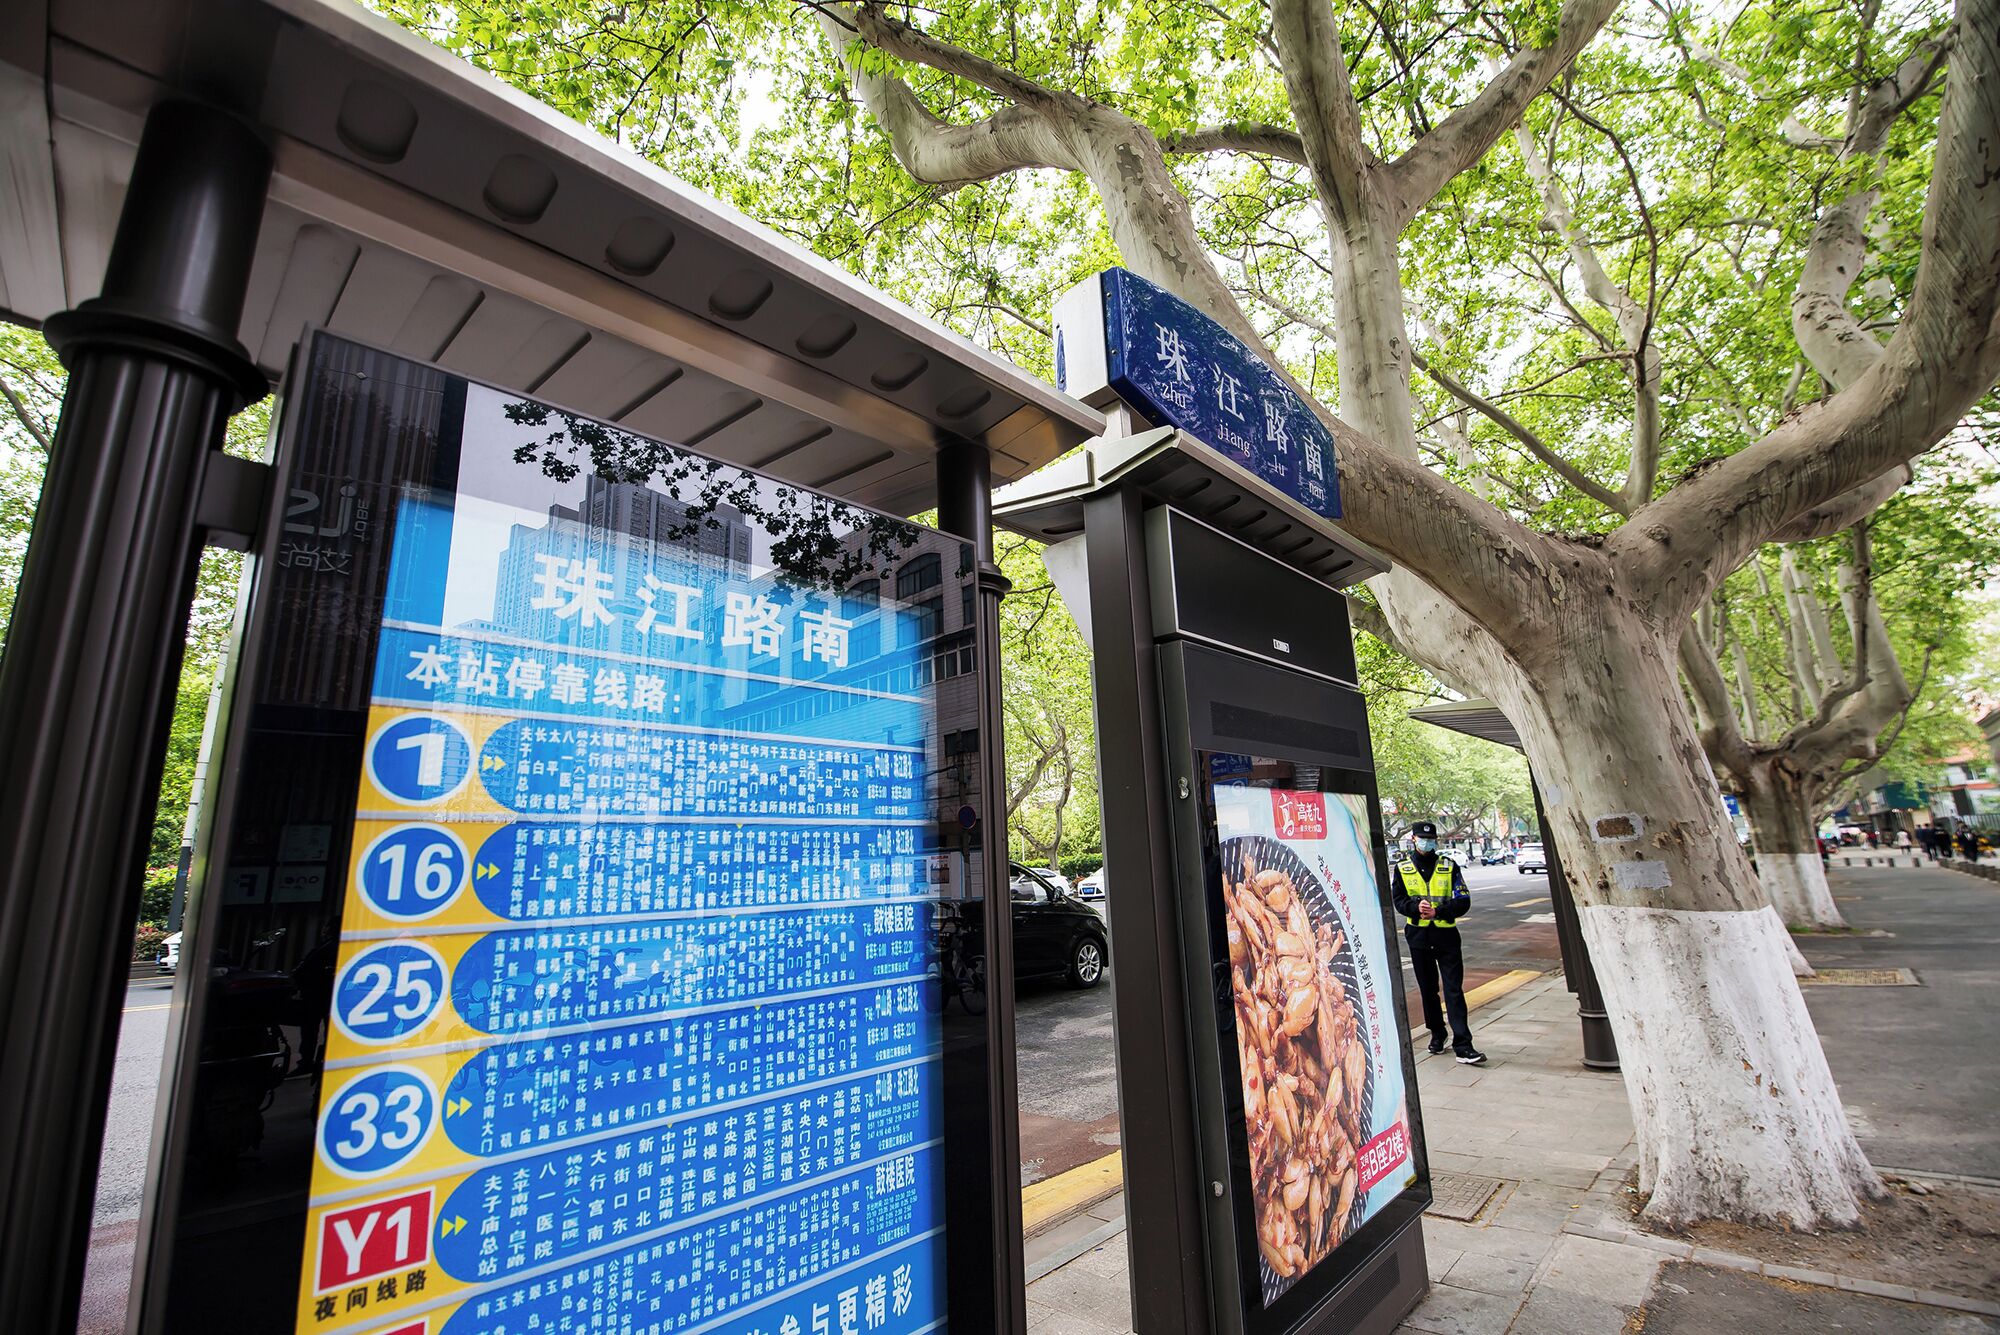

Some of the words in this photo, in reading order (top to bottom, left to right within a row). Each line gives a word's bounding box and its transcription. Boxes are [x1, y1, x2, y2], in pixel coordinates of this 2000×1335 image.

[1154, 321, 1324, 481] 珠江路南
[1160, 380, 1188, 410] zhu
[1216, 419, 1251, 457] jiang
[1308, 482, 1327, 501] nan
[531, 552, 855, 668] 珠江路南
[395, 732, 447, 787] 1
[514, 727, 532, 809] 夫子庙总站
[529, 727, 547, 809] 长白街
[378, 842, 455, 901] 16
[874, 904, 914, 934] 鼓楼医院
[347, 958, 434, 1028] 25
[642, 1031, 654, 1116] 武定门
[671, 1026, 685, 1110] 市第一医院
[716, 1019, 726, 1100] 三元巷
[728, 1017, 738, 1096] 新街口南
[740, 1015, 749, 1094] 新街口北
[776, 1010, 785, 1086] 鼓楼医院
[827, 1001, 835, 1074] 中央门立交
[334, 1081, 423, 1160] 33
[481, 1056, 498, 1154] 雨花台南大门
[557, 1045, 572, 1136] 宁南小区
[702, 1120, 718, 1207] 鼓楼医院
[743, 1112, 757, 1195] 玄武湖公园
[781, 1102, 794, 1182] 玄武湖隧道
[799, 1099, 811, 1177] 中央门立交
[816, 1094, 828, 1171] 中央门东
[1368, 1129, 1404, 1177] B座2楼
[534, 1162, 556, 1260] 八一医院
[587, 1149, 607, 1243] 大行宫南
[612, 1142, 632, 1236] 新街口东
[636, 1136, 654, 1227] 新街口北
[876, 1154, 915, 1195] 鼓楼医院
[334, 1206, 412, 1275] Y1
[478, 1175, 502, 1277] 夫子庙总站
[753, 1212, 764, 1297] 鼓楼医院
[788, 1201, 798, 1282] 山西路
[852, 1179, 860, 1257] 南京西站
[314, 1269, 427, 1322] 夜间线路
[677, 1237, 690, 1327] 钓鱼台
[717, 1224, 728, 1311] 三元巷
[729, 1220, 740, 1306] 新街口南
[748, 1263, 913, 1335] 与更精彩
